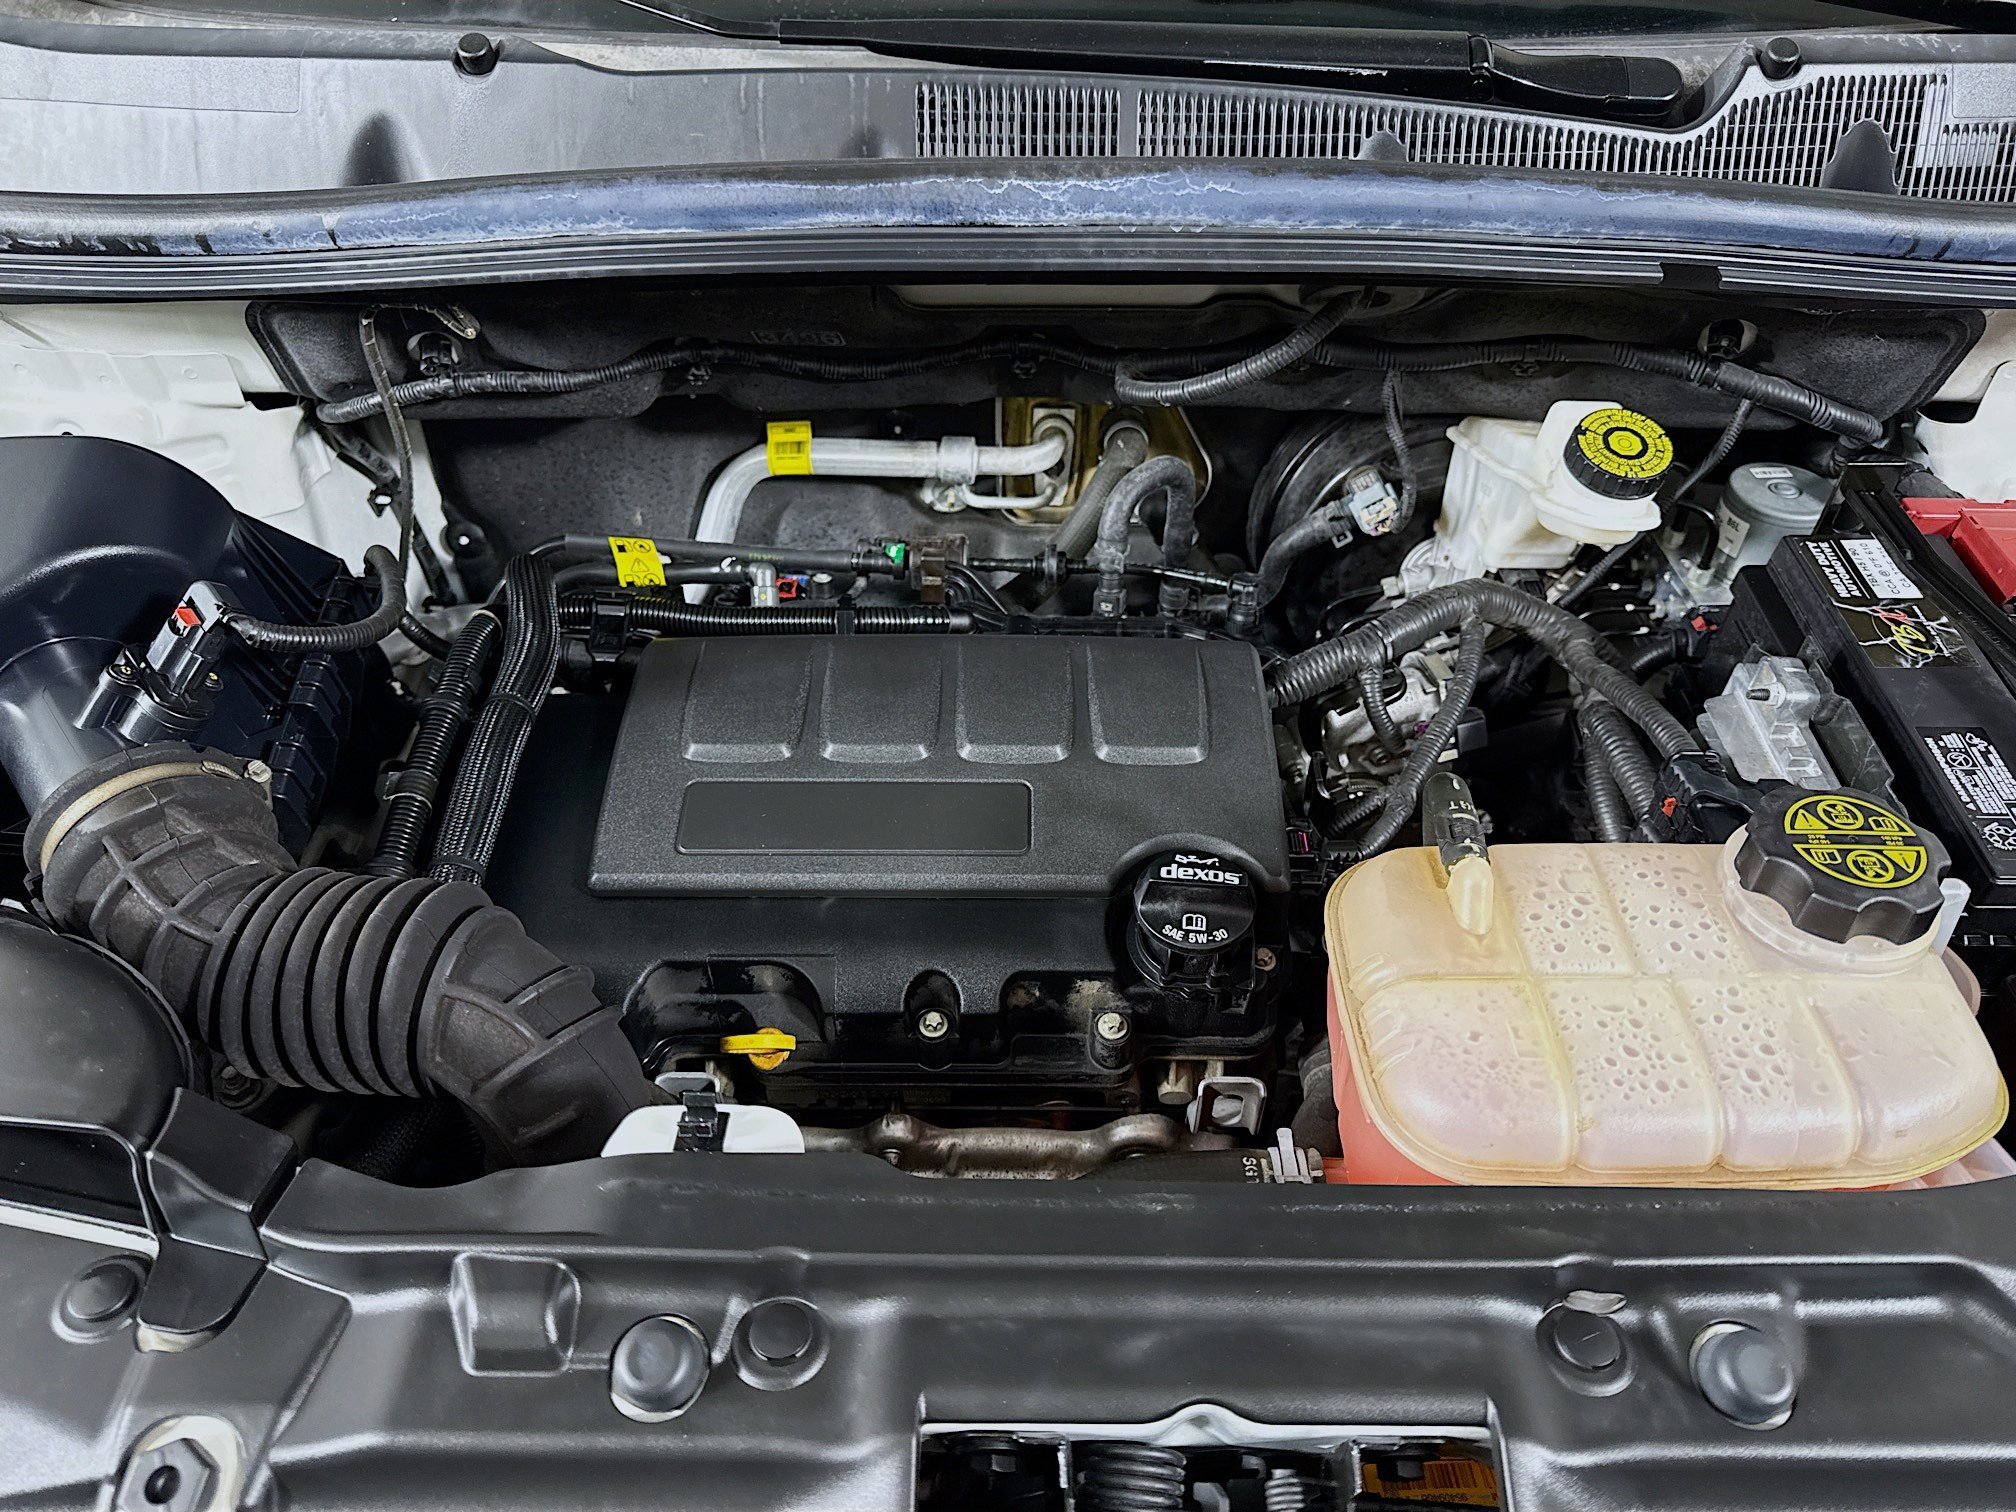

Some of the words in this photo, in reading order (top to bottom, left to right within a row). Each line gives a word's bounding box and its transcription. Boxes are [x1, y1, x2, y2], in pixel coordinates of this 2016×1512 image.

[1805, 541, 1830, 566] DUTY
[1818, 541, 1862, 597] AUTOMOTIVE
[1821, 566, 1851, 597] HEAVY
[1885, 579, 1900, 594] CCA
[1160, 863, 1240, 885] dexos
[1161, 924, 1184, 941] SAE
[1188, 928, 1229, 944] 5W-30
